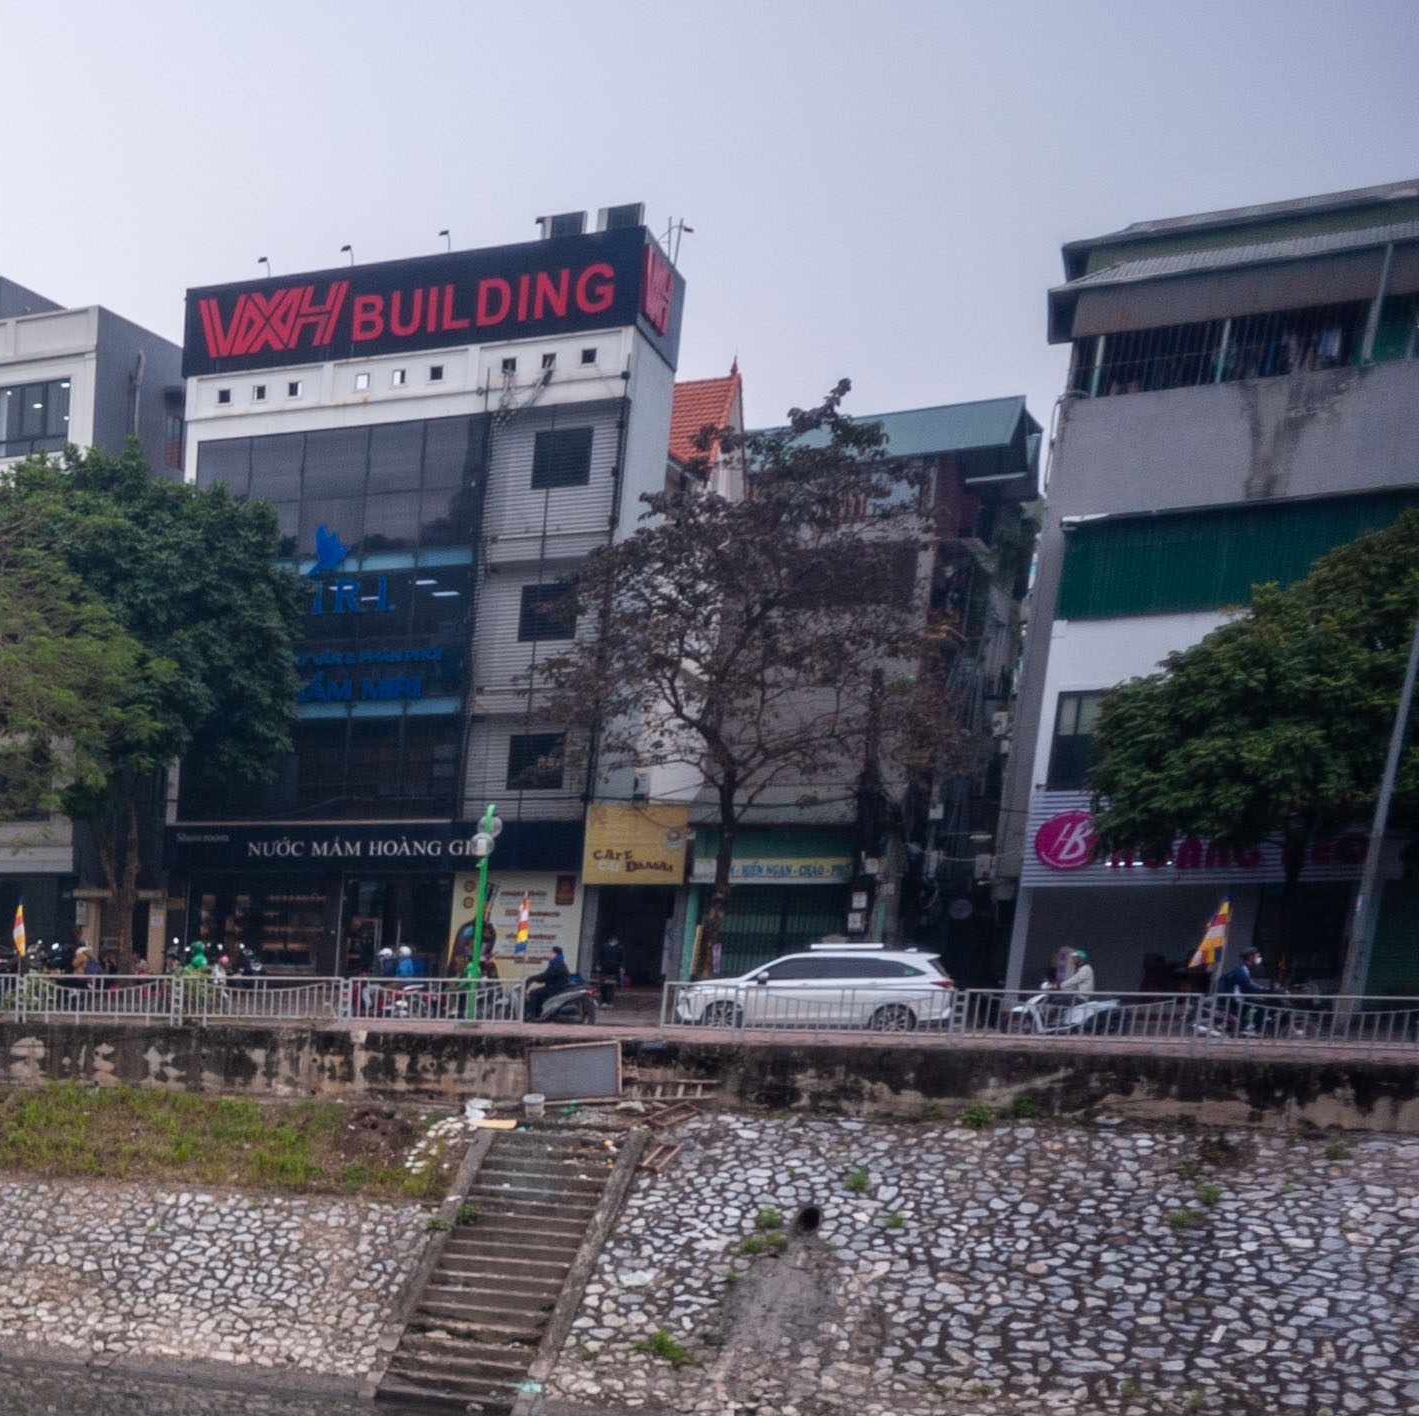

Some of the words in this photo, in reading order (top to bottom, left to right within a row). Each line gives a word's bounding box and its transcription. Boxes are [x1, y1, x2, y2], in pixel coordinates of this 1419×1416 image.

[351, 262, 615, 342] BUILDING
[362, 676, 423, 700] MIRI
[177, 832, 229, 842] Showroom
[247, 836, 304, 857] NƯỚC
[369, 835, 442, 856] HOÀNG
[448, 840, 483, 856] GI
